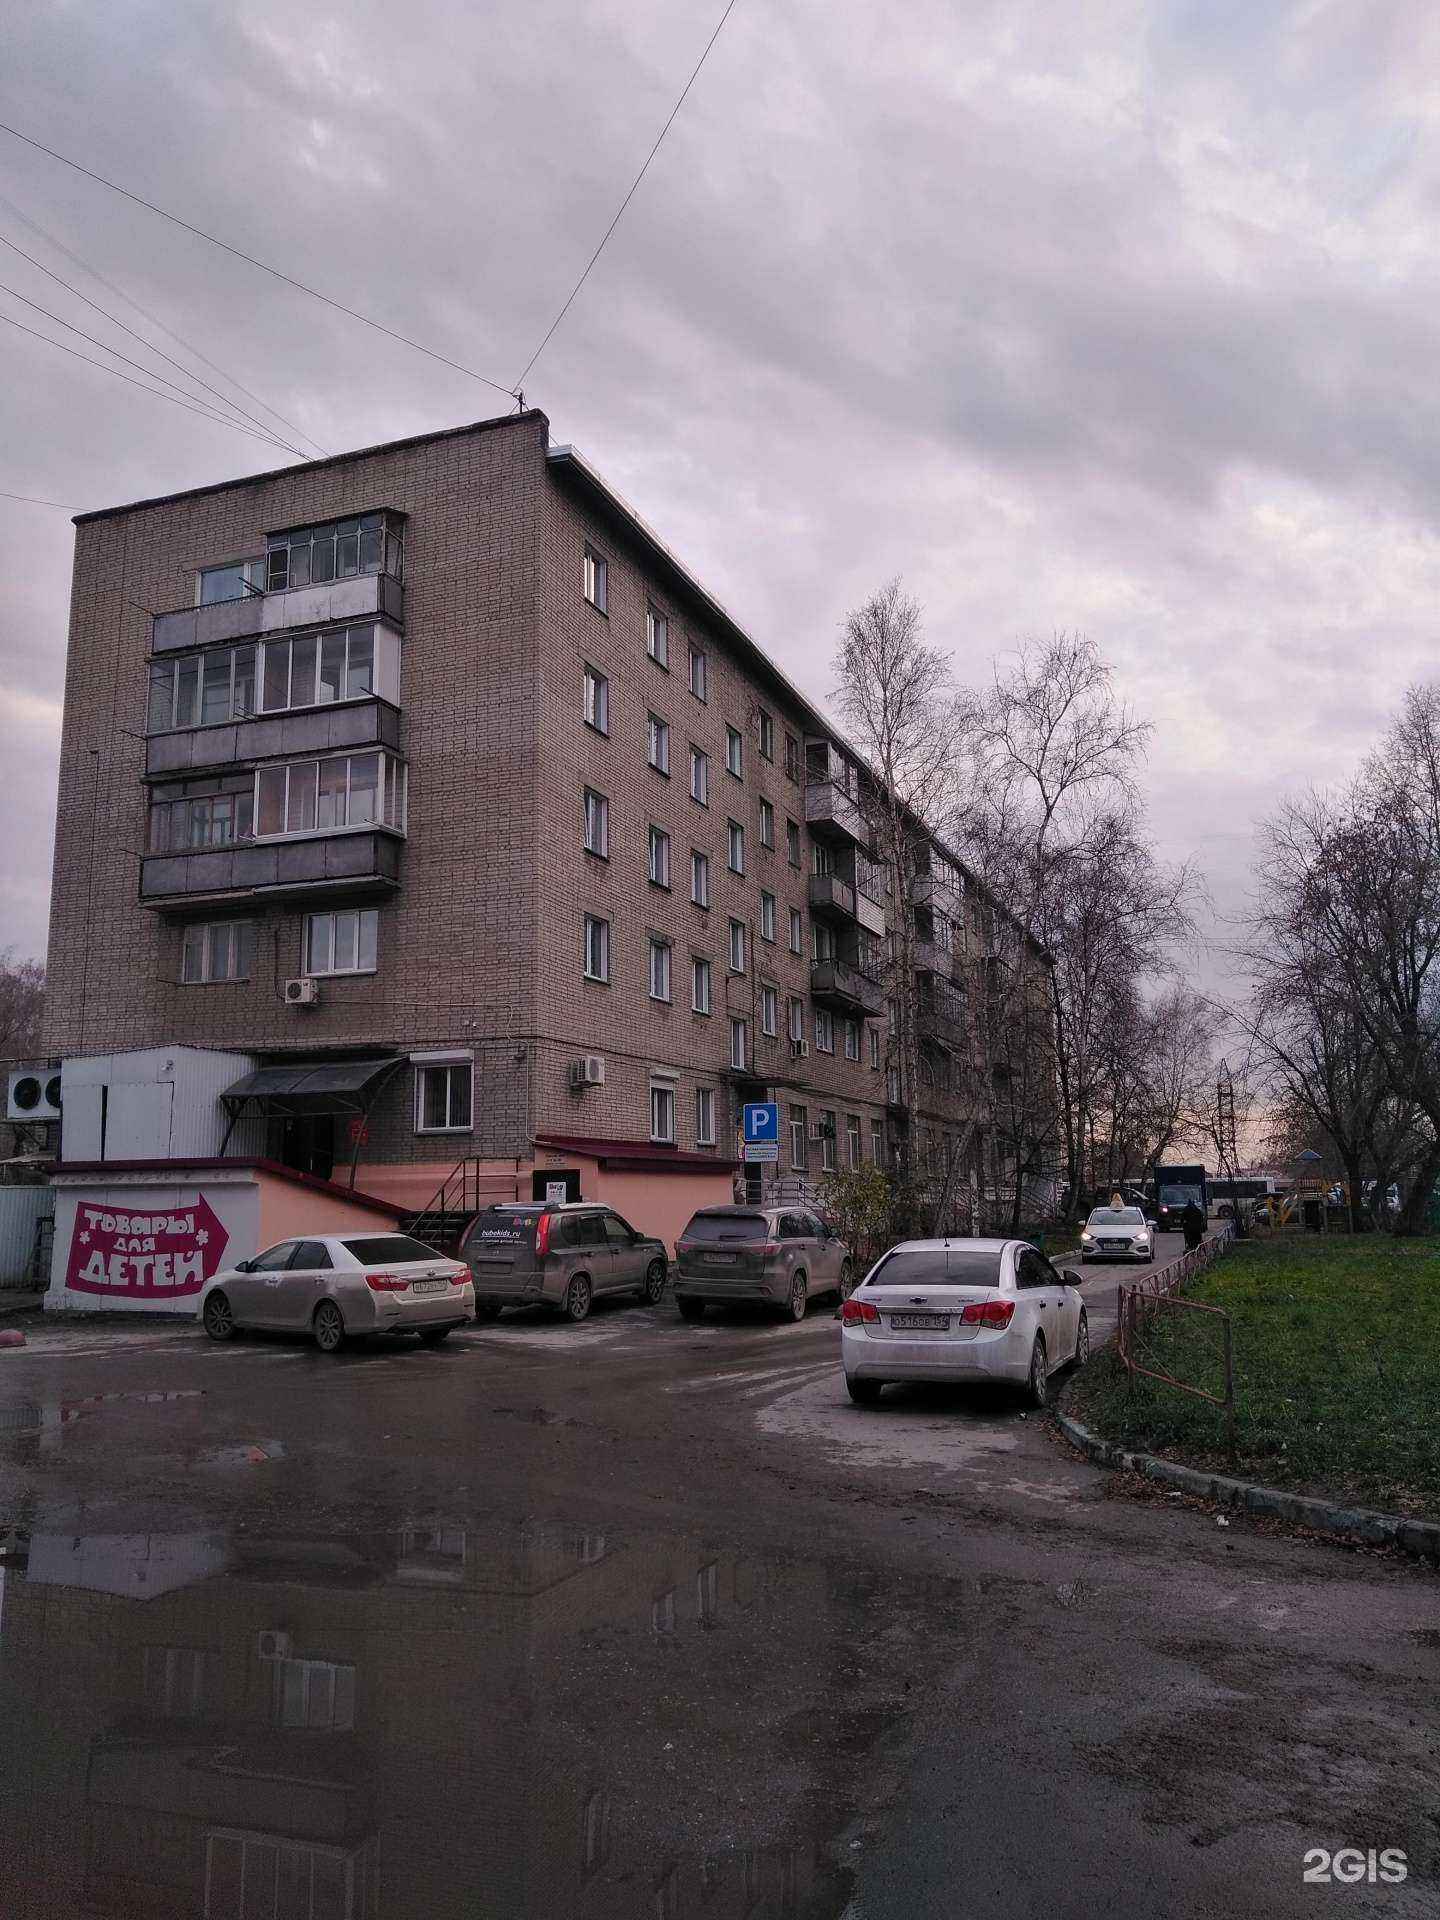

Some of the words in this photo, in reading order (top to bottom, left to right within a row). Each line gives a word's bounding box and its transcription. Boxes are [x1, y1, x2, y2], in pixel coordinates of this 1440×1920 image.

[752, 1109, 770, 1136] P
[113, 1237, 155, 1252] ДЛЯ
[78, 1249, 204, 1286] ДЕТЕЙ
